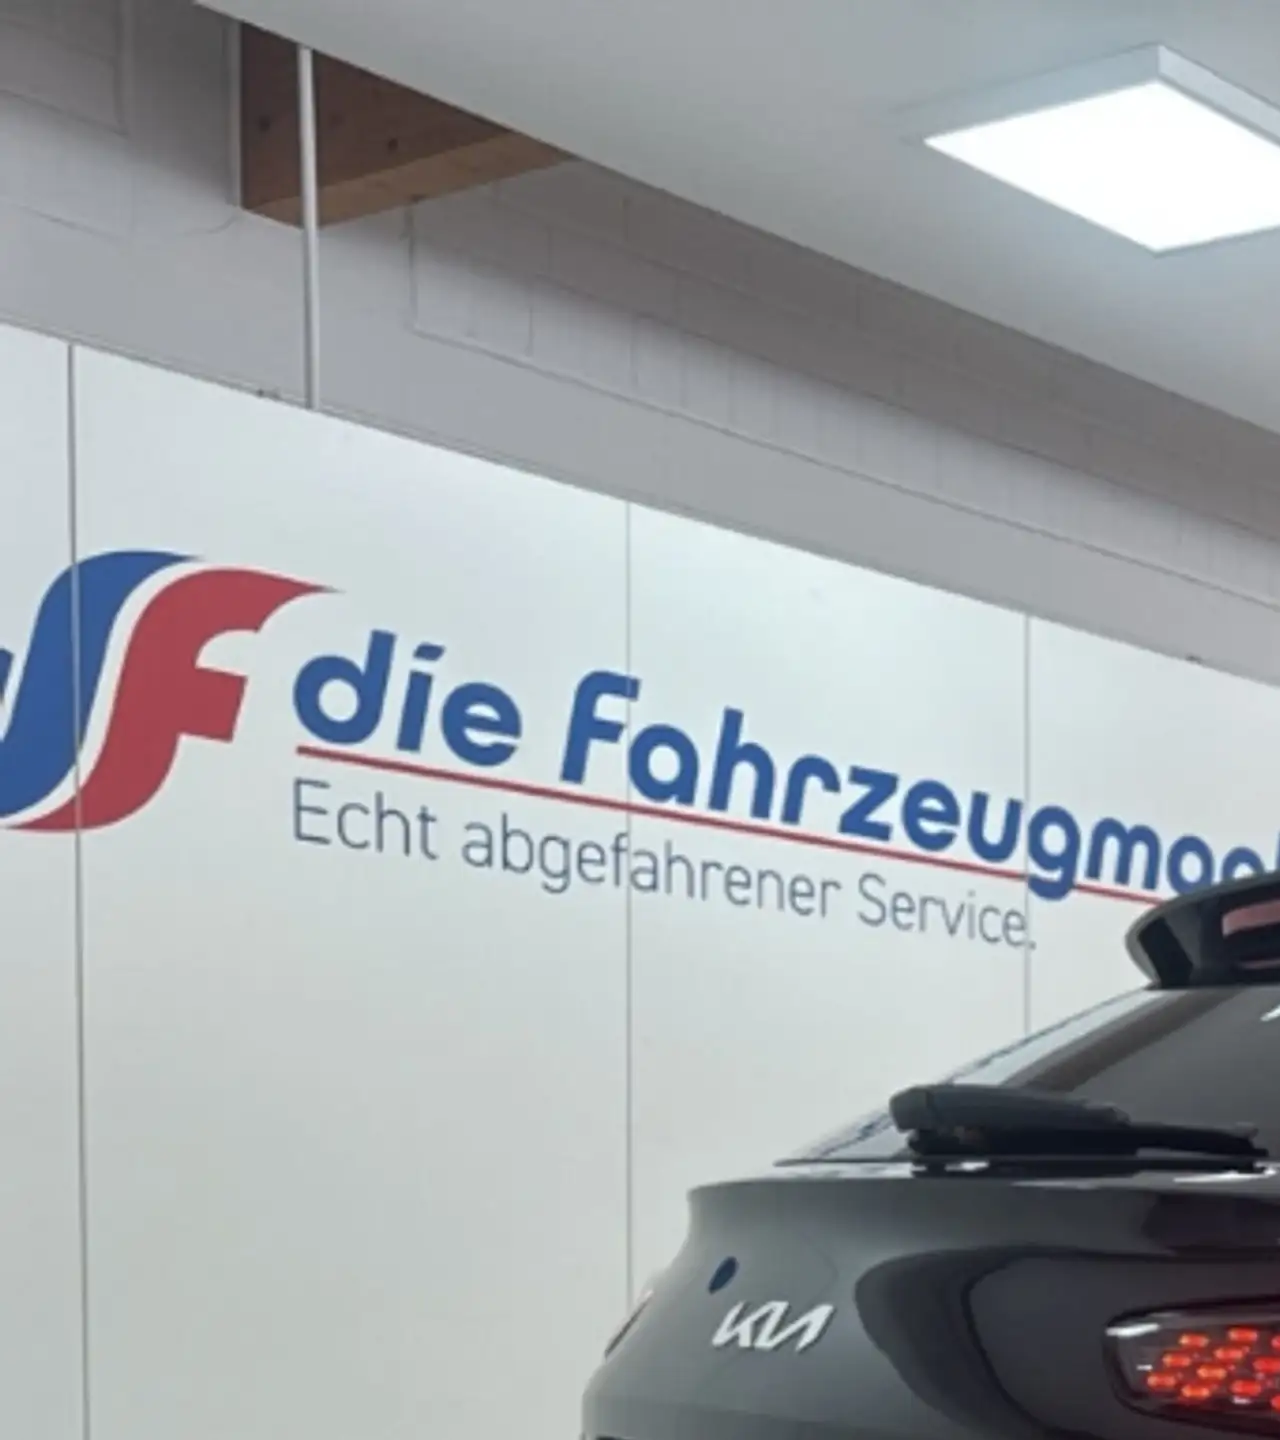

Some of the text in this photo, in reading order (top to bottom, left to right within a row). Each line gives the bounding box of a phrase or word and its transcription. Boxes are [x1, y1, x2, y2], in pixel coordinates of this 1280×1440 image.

[292, 629, 522, 767] die
[293, 778, 1037, 950] Echt abgefahrener Service.
